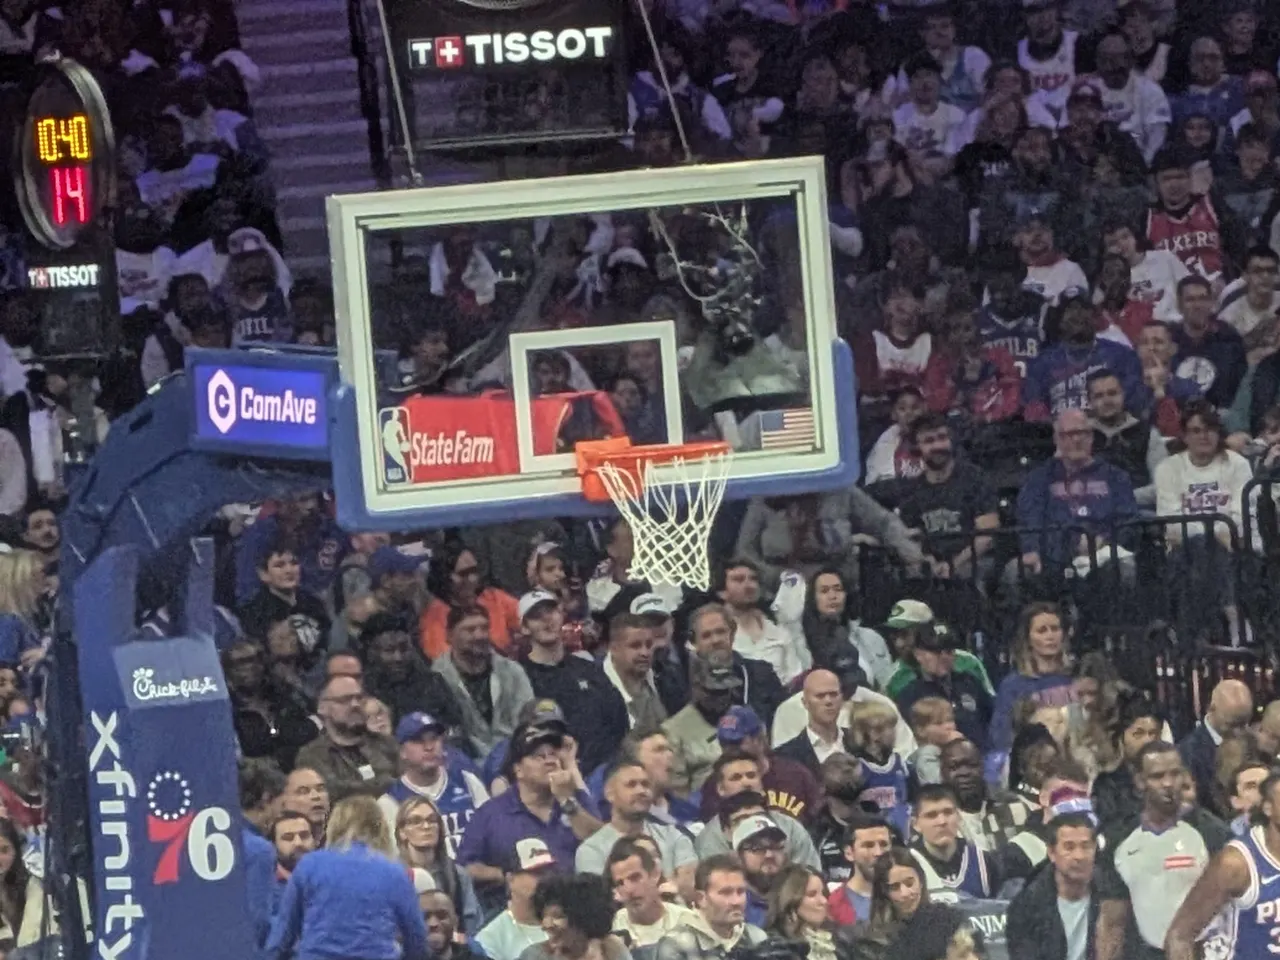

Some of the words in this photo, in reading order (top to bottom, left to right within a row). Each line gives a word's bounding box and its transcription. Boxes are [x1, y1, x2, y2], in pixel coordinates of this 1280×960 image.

[465, 27, 612, 65] TISSOT
[37, 116, 89, 162] 10:40
[53, 166, 86, 225] 14
[48, 264, 99, 288] TISSOT
[241, 387, 316, 425] ComAve
[410, 432, 453, 466] State
[453, 430, 494, 464] Farm
[146, 806, 235, 886] 76
